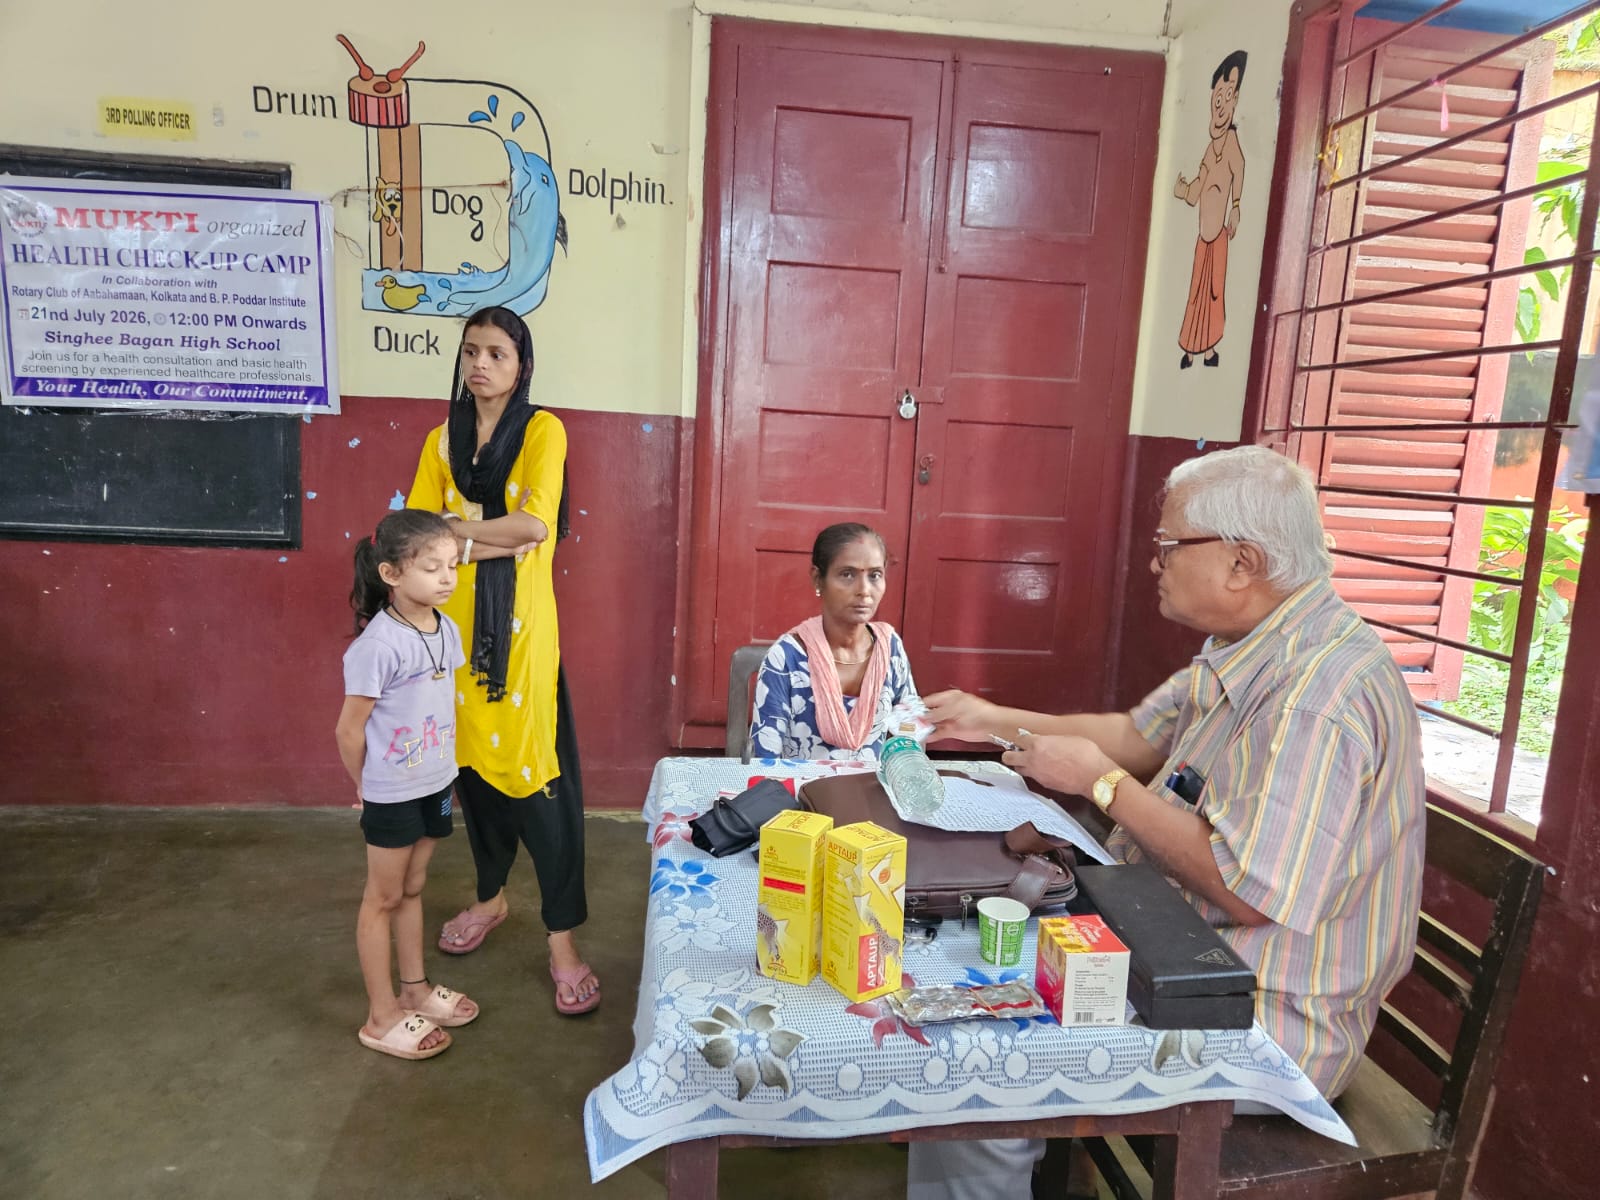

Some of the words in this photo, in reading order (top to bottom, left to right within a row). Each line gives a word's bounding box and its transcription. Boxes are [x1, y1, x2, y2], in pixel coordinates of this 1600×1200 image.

[253, 85, 337, 119] Drum
[105, 107, 120, 124] 3RD
[123, 109, 156, 127] POLLING
[158, 111, 190, 130] OFFICER
[568, 167, 673, 215] Dolphin.
[54, 207, 199, 233] MUKTI
[207, 219, 307, 239] organized
[432, 188, 484, 242] Dog
[11, 243, 111, 267] HEALTH
[116, 247, 238, 271] CHECK-UP
[243, 252, 311, 275] CAMP
[102, 275, 113, 285] In
[116, 275, 191, 288] Collaboration
[195, 279, 218, 289] with
[12, 285, 43, 299] Rotary
[46, 287, 68, 298] Club
[71, 287, 81, 298] of
[151, 289, 187, 302] Kolkata
[189, 292, 207, 303] and
[210, 292, 220, 304] B.
[222, 293, 231, 304] P.
[233, 293, 266, 306] Poddar
[269, 295, 306, 308] Institute
[31, 306, 69, 322] 21nd
[74, 308, 106, 326] July
[111, 309, 151, 325] 2026,
[169, 312, 209, 326] 12:00
[214, 313, 237, 328] PM
[242, 315, 307, 331] Onwards
[45, 331, 113, 347] Singhee
[119, 332, 174, 349] Bagan
[180, 335, 221, 352] High
[226, 337, 281, 351] School
[374, 326, 441, 356] Duck
[28, 350, 52, 361] Join
[57, 353, 70, 362] us
[73, 351, 89, 362] for
[92, 354, 100, 363] a
[103, 352, 140, 364] health
[143, 354, 212, 367] consultation
[216, 356, 238, 367] and
[241, 357, 272, 369] basic
[273, 358, 307, 370] health
[21, 364, 78, 376] screening
[81, 364, 96, 377] by
[100, 365, 171, 378] experienced
[175, 367, 236, 380] healthcare
[239, 369, 316, 383] professionals.
[36, 379, 77, 393] Your
[81, 380, 148, 397] Health,
[153, 383, 190, 396] Our
[195, 384, 309, 401] Commitment.
[828, 841, 857, 861] APTAUP
[867, 937, 879, 988] APTAUP
